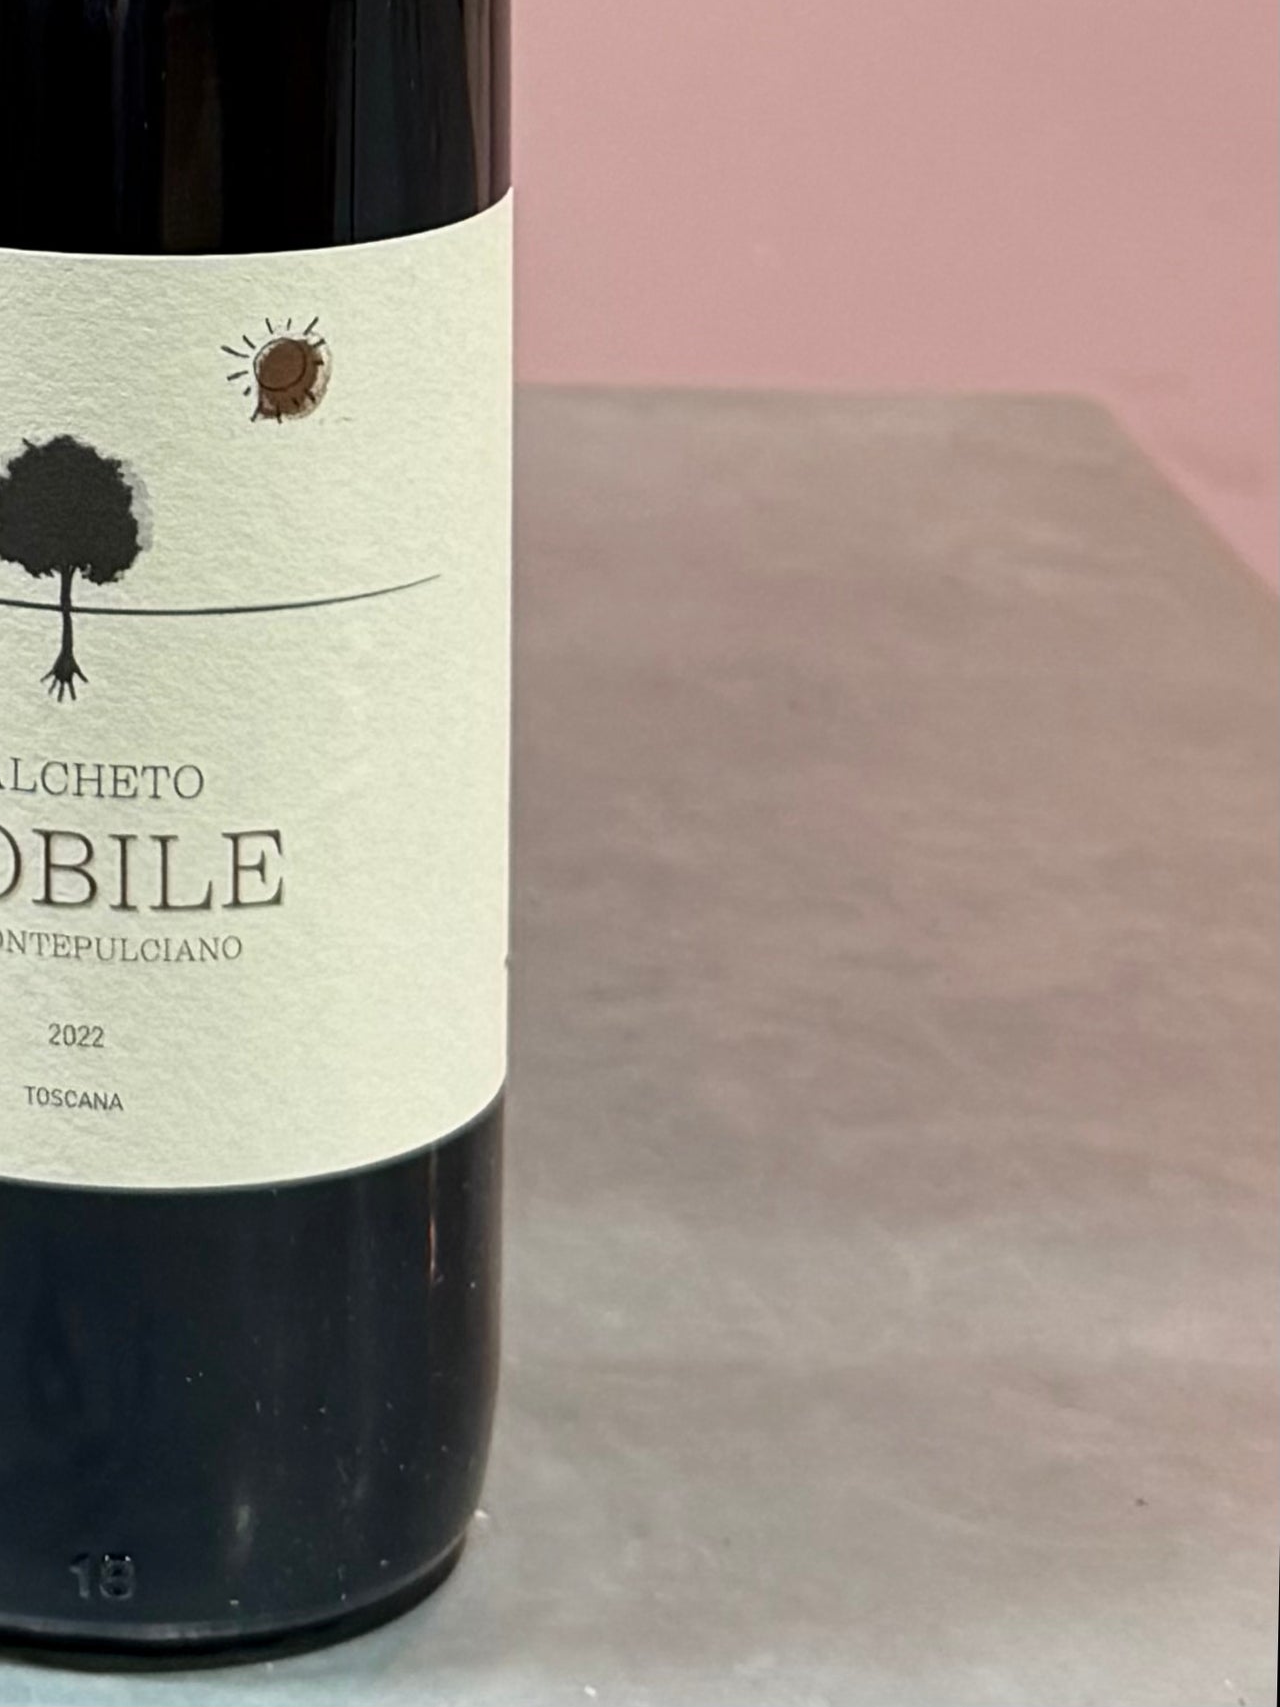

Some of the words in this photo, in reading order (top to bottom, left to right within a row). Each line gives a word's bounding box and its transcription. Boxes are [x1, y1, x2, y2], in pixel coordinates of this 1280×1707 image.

[47, 1023, 106, 1049] 2022
[24, 1085, 124, 1112] TOSCANA
[68, 1551, 138, 1603] 18
